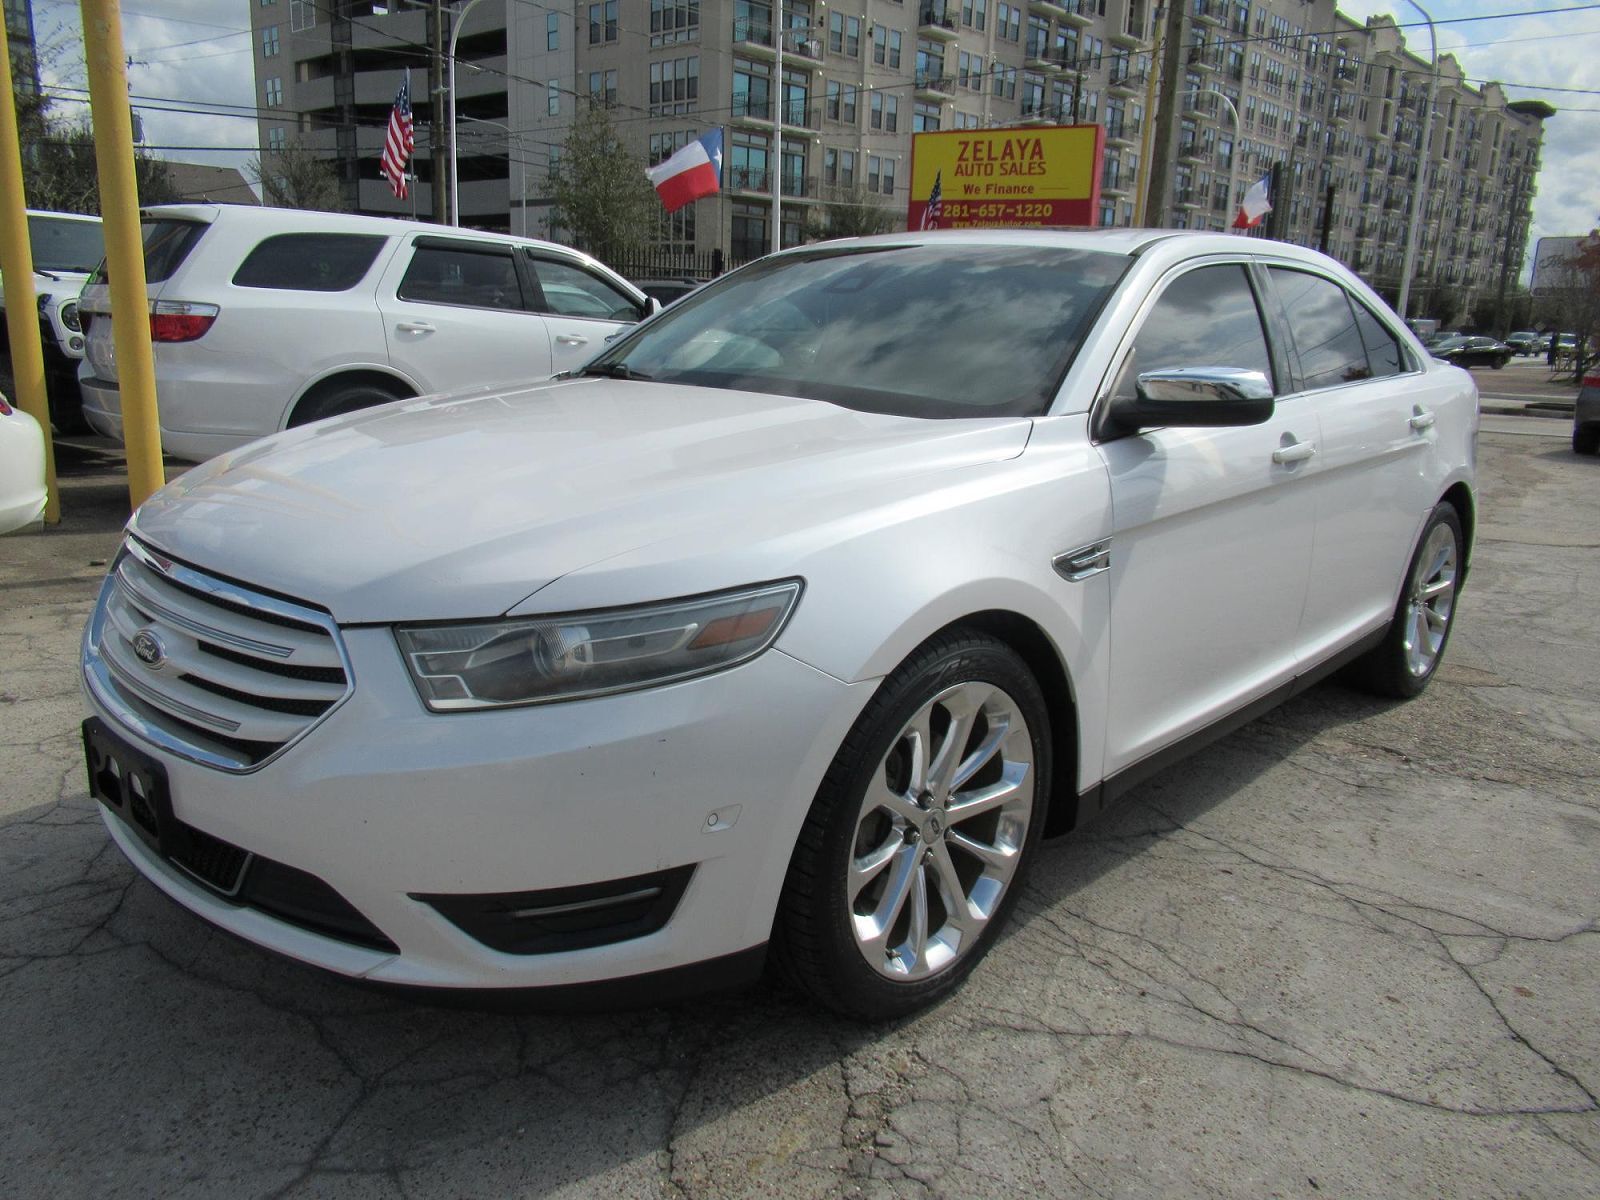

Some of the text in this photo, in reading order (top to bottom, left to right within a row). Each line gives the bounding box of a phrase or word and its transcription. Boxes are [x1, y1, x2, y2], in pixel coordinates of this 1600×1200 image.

[957, 138, 1044, 162] ZELAYA
[954, 161, 1046, 177] AUTO SALES
[963, 183, 1034, 195] We Finance
[943, 203, 1053, 217] 281-657-1220
[136, 637, 156, 661] Ford
